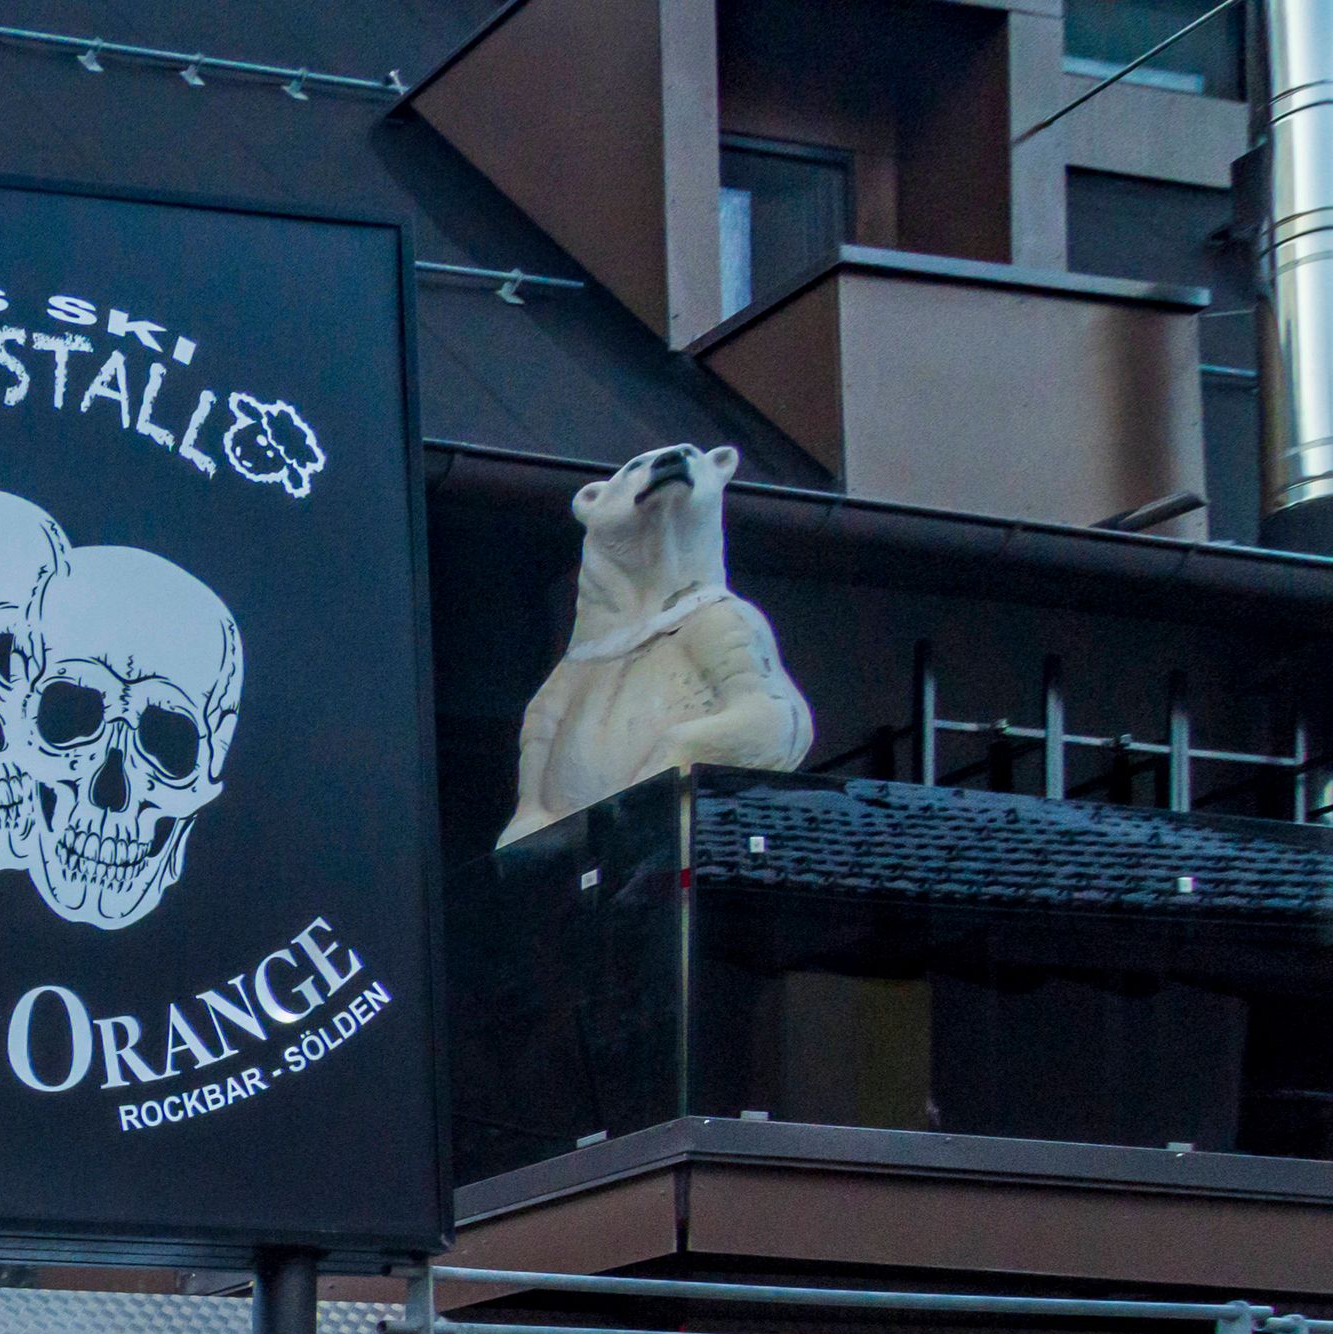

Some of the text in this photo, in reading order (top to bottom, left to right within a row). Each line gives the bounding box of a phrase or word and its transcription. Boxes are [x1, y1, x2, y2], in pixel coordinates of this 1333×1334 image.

[47, 295, 196, 365] SKI
[118, 1066, 269, 1131] ROCKBAR
[284, 981, 392, 1073] SÖLDEN
